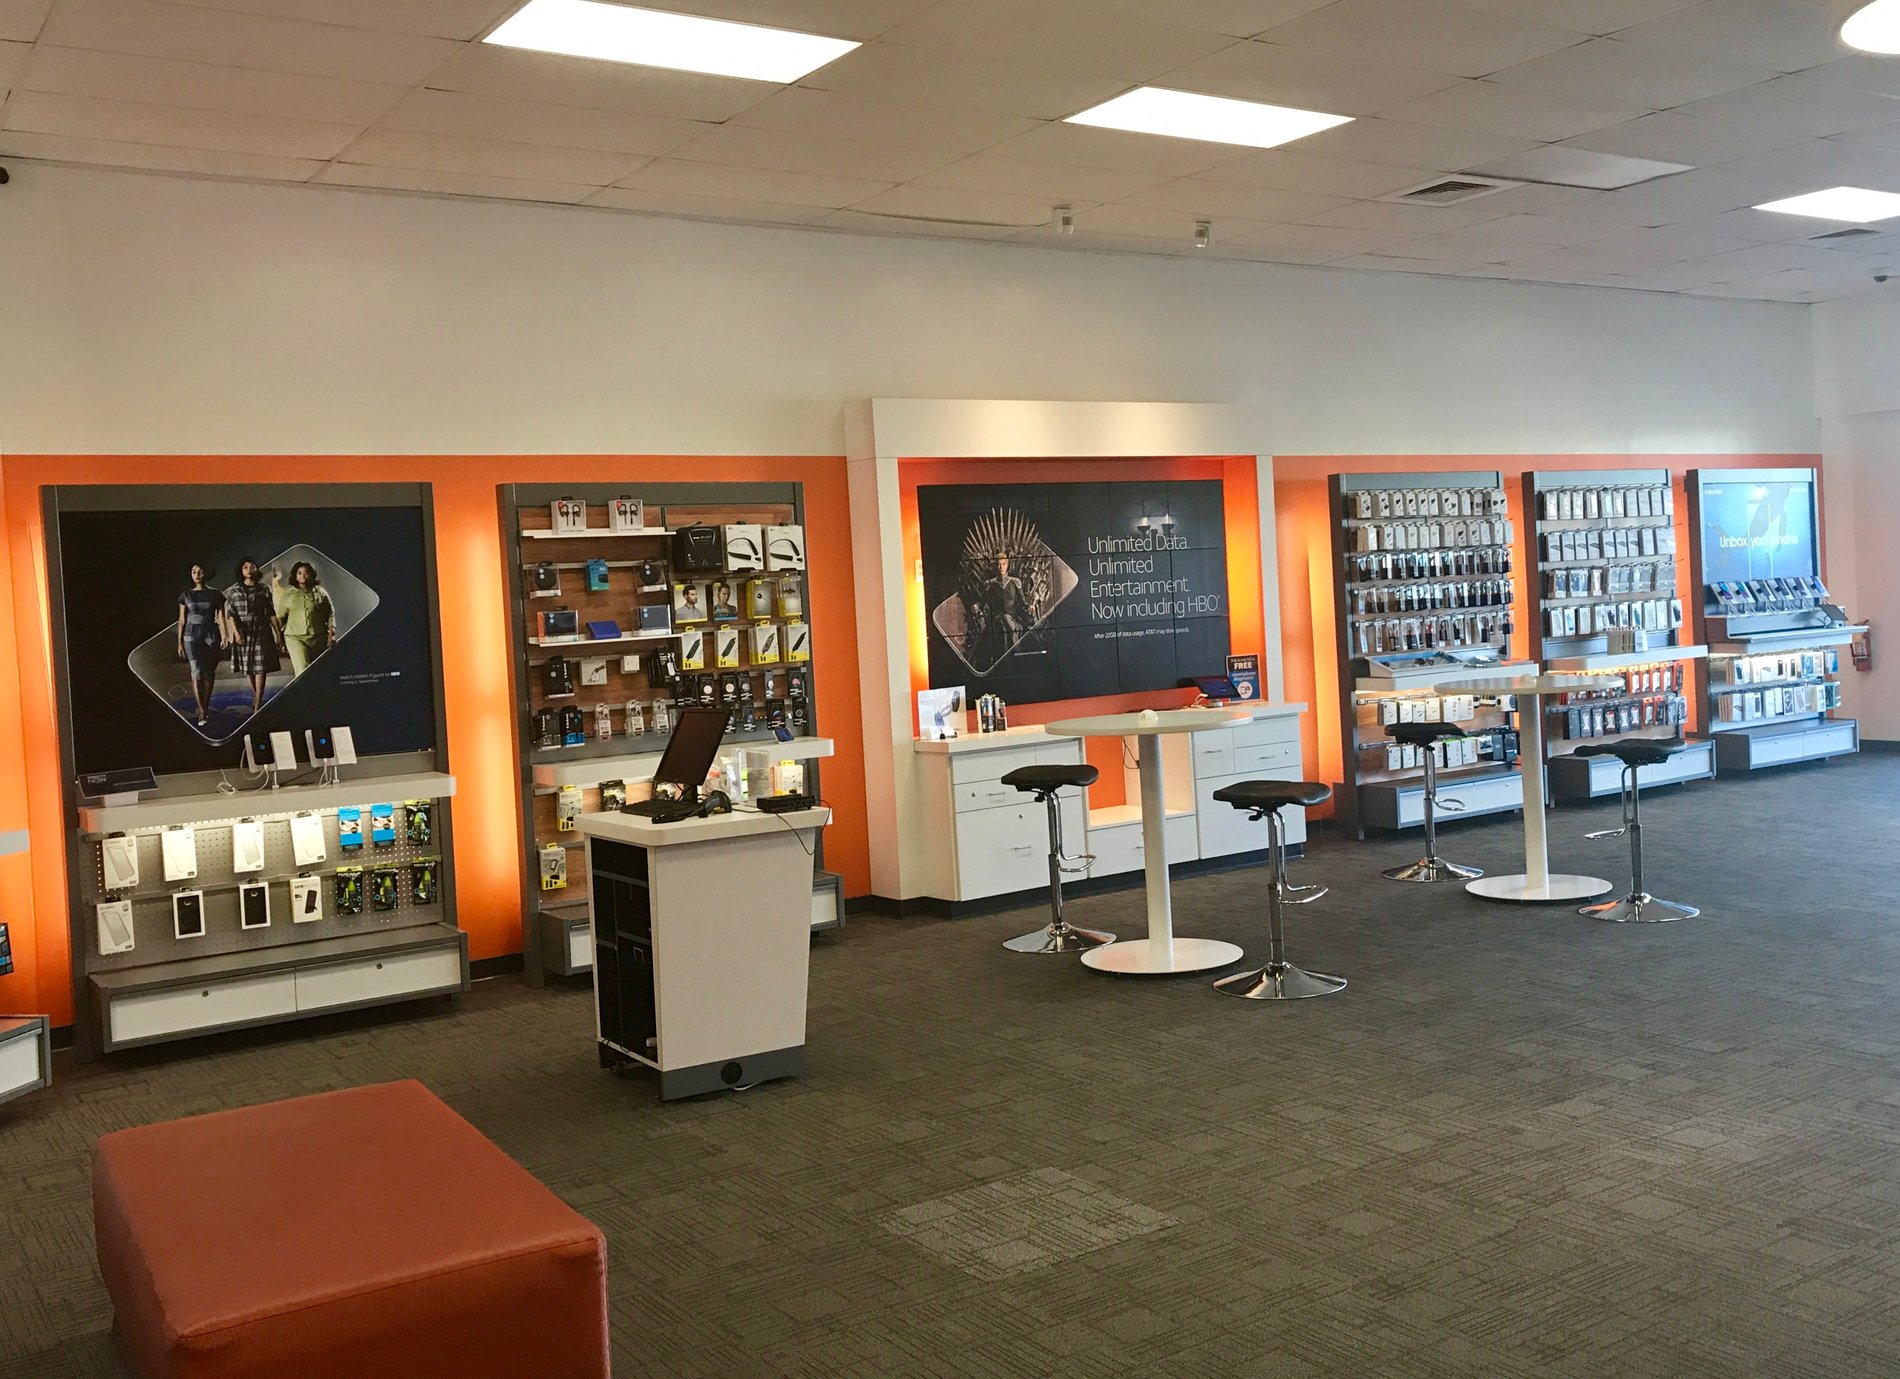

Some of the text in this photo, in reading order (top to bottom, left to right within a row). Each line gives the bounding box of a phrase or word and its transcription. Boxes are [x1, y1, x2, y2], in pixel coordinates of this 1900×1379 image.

[1087, 533, 1190, 554] Unlimited Data.
[1719, 535, 1748, 548] Unbox
[1089, 555, 1154, 576] Unlimited
[1091, 602, 1125, 620] Now
[1127, 597, 1185, 618] including
[1234, 661, 1253, 670] FREE
